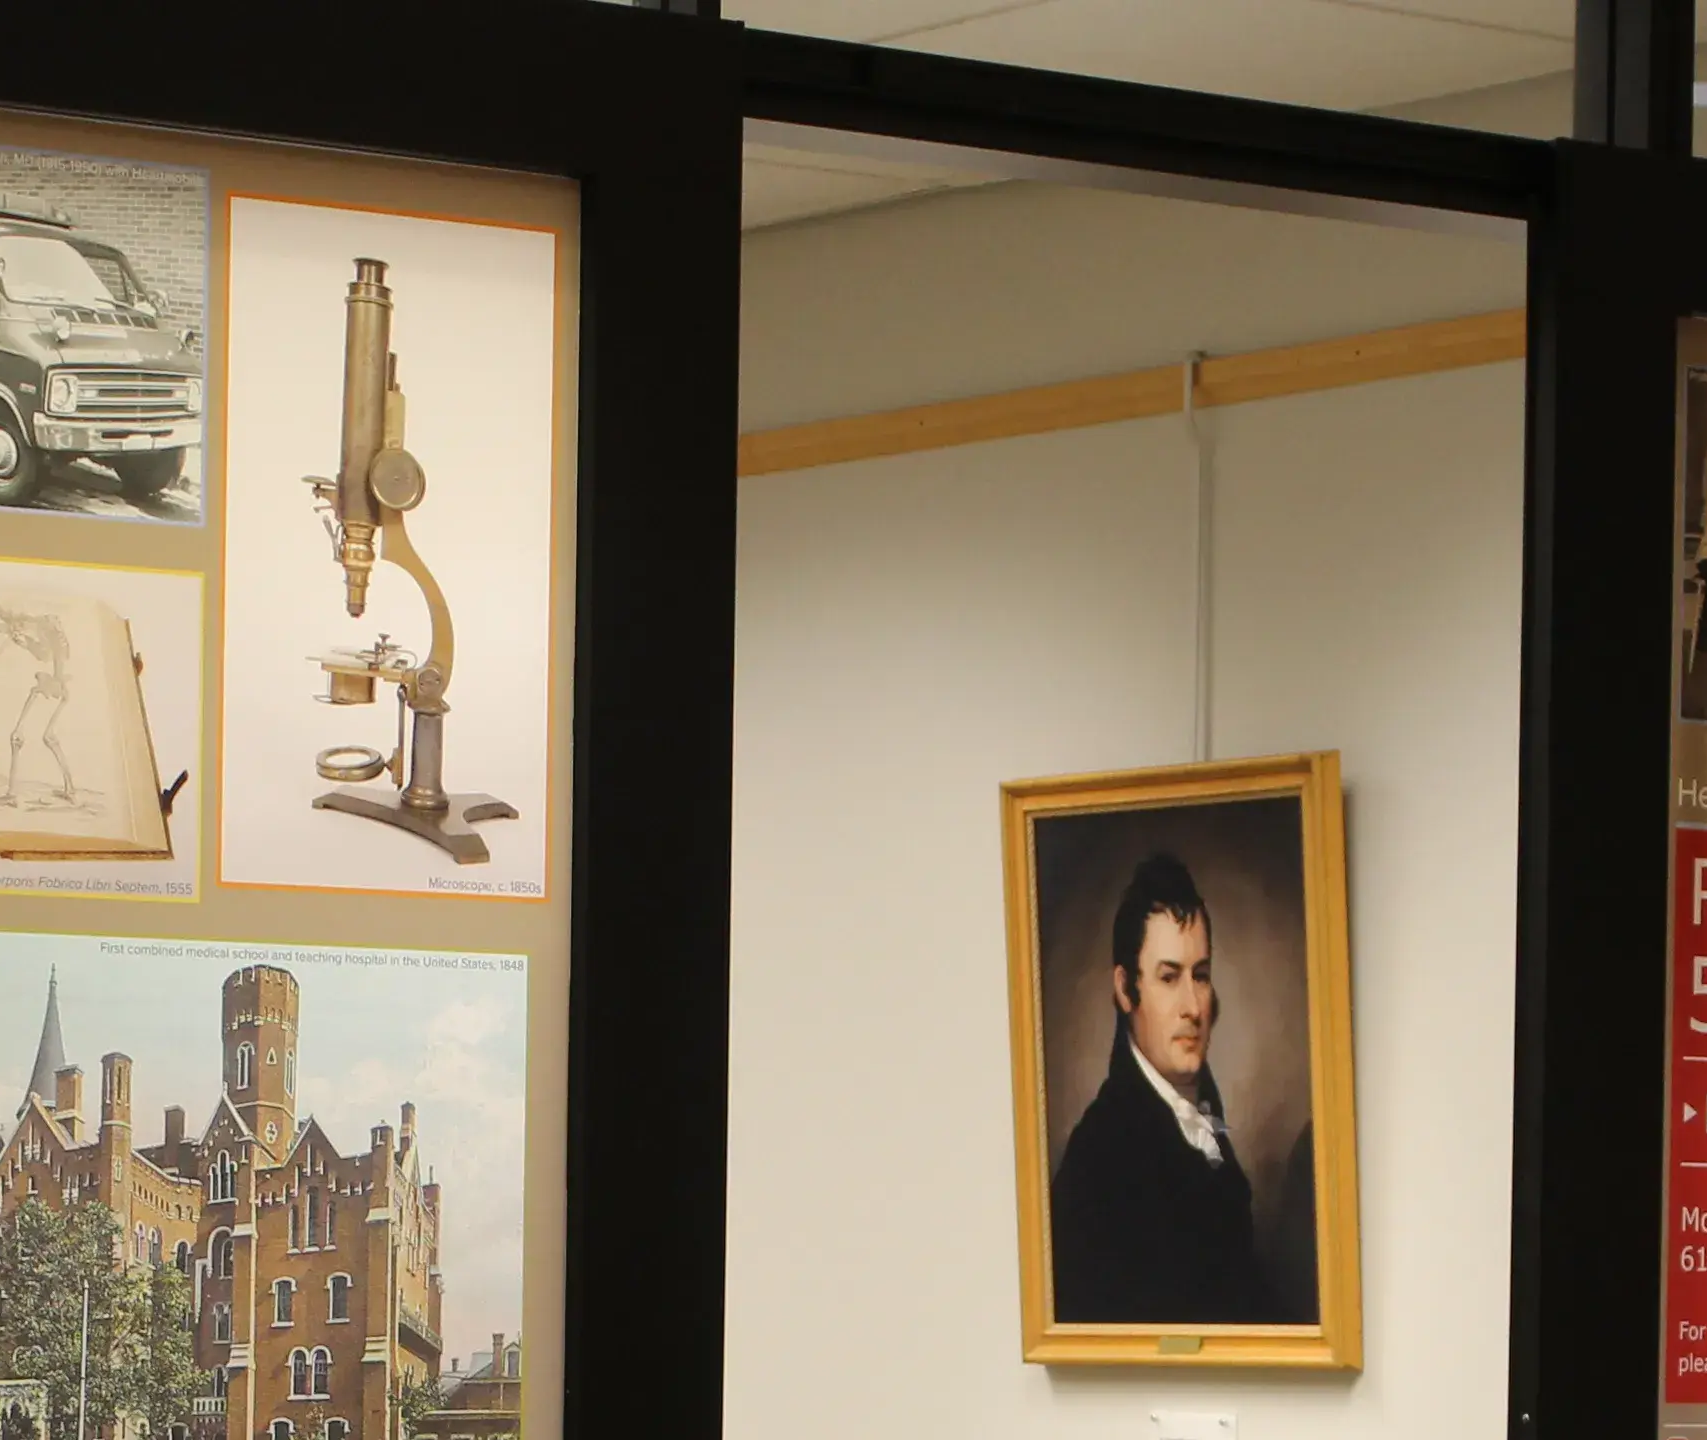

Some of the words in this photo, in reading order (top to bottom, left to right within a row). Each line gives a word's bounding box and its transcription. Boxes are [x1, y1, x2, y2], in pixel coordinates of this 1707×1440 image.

[38, 876, 83, 890] Fabrica
[85, 878, 111, 891] Libri
[115, 879, 162, 895] Septem,
[166, 882, 193, 895] 1555
[428, 876, 495, 893] Microscope,
[510, 880, 542, 894] 1850s
[100, 942, 124, 955] First
[127, 944, 183, 957] combined
[186, 945, 230, 959] medical
[232, 947, 269, 961] school
[271, 949, 293, 962] and
[295, 950, 342, 966] teaching
[345, 953, 387, 968] hospital
[390, 954, 400, 966] in
[403, 955, 421, 967] the
[423, 956, 458, 969] United
[461, 958, 497, 971] States,
[500, 960, 525, 972] 1848
[1678, 1320, 1707, 1342] For
